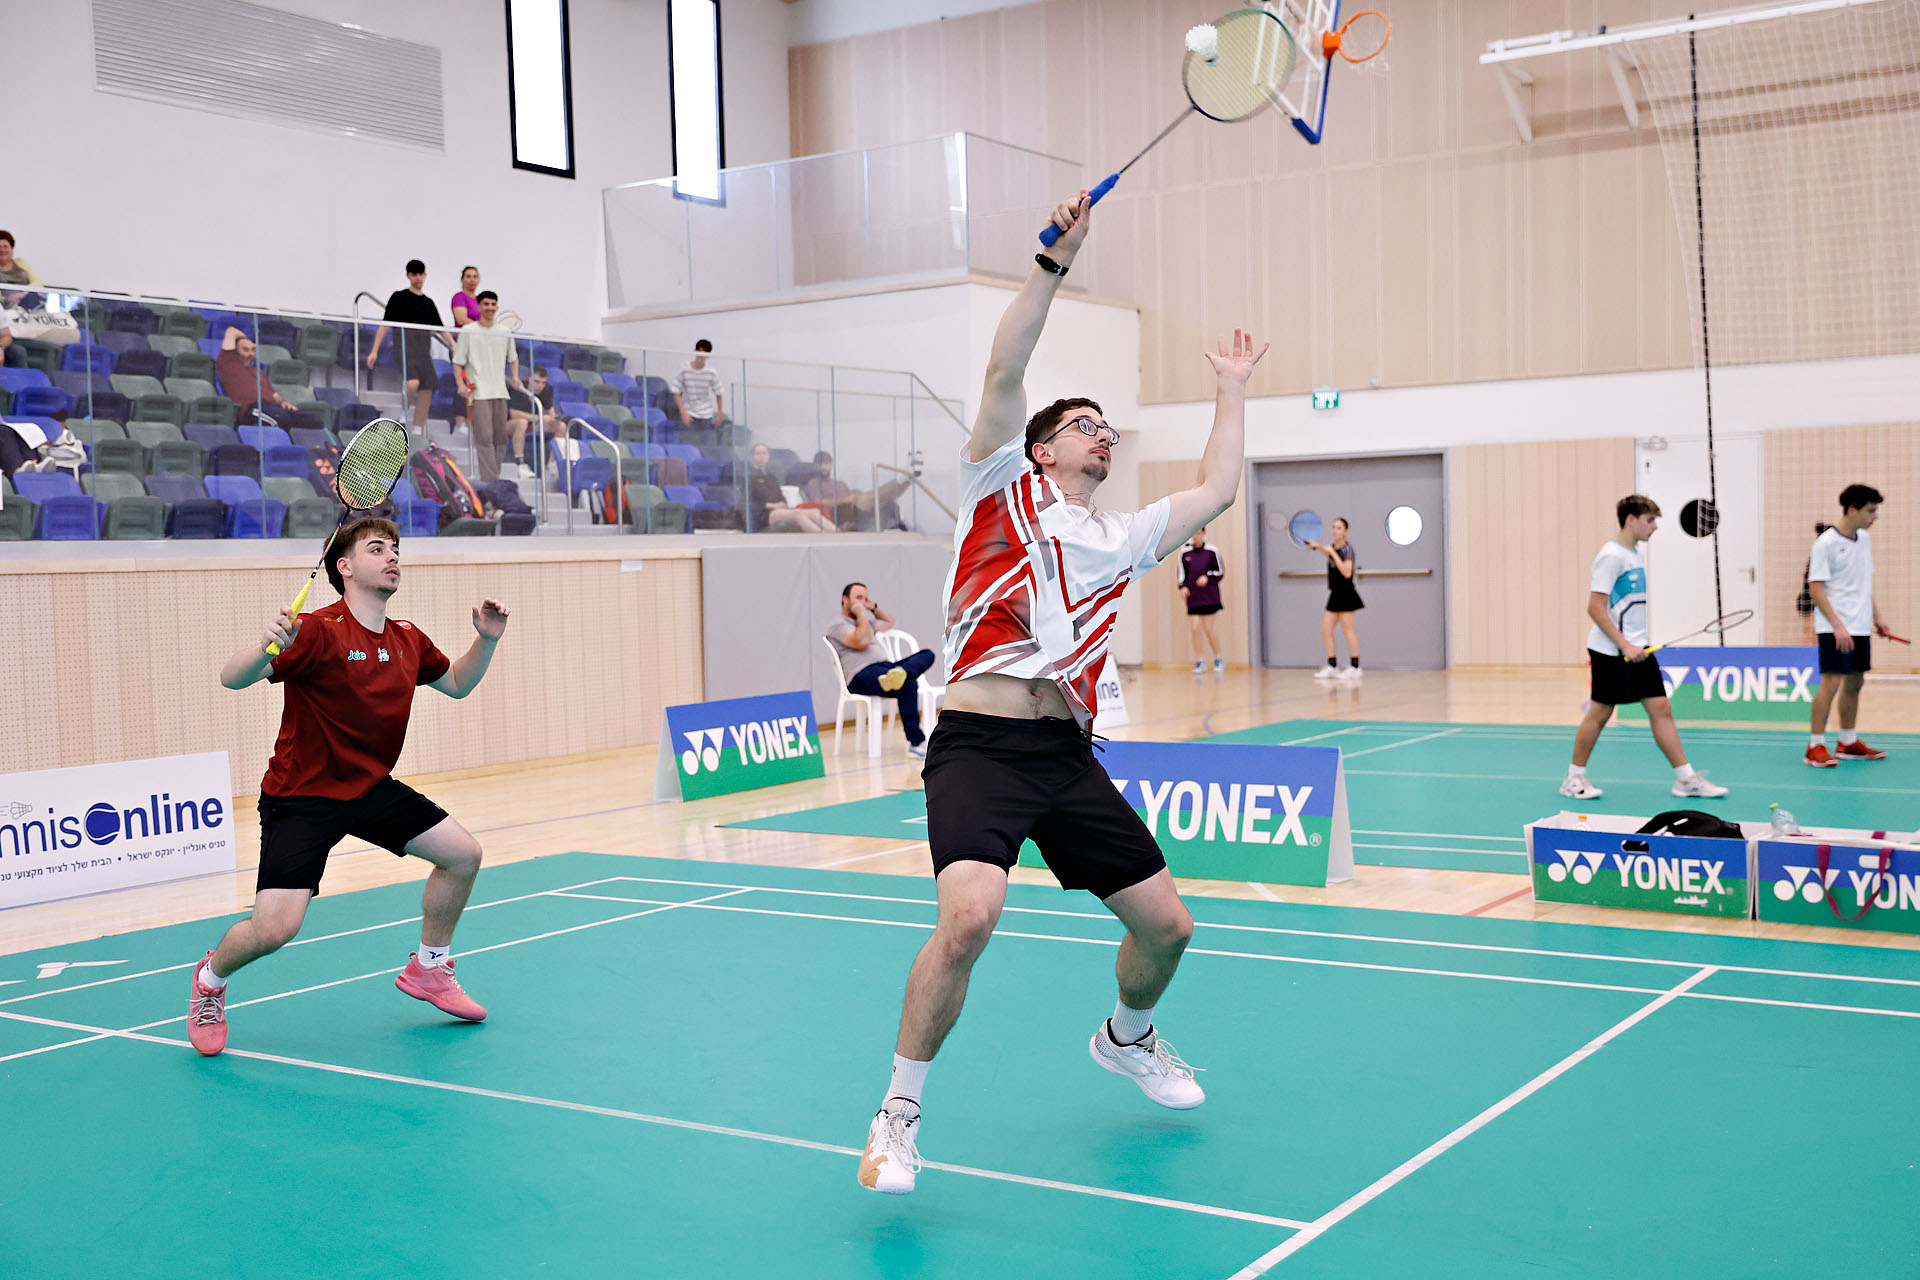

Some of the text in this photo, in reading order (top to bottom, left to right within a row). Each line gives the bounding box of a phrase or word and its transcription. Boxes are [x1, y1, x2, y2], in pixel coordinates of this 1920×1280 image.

[1696, 666, 1814, 703] YONEX
[729, 715, 814, 766] YONEX
[1139, 780, 1314, 846] YONEX
[183, 843, 207, 855] אונליין
[208, 840, 226, 849] טניס
[127, 852, 153, 862] ישראל
[155, 848, 175, 859] יונקס
[46, 863, 68, 873] לציוד
[71, 860, 88, 873] שלך
[91, 857, 112, 868] הבית
[14, 868, 44, 879] מקצועי
[1612, 853, 1726, 895] YONEX
